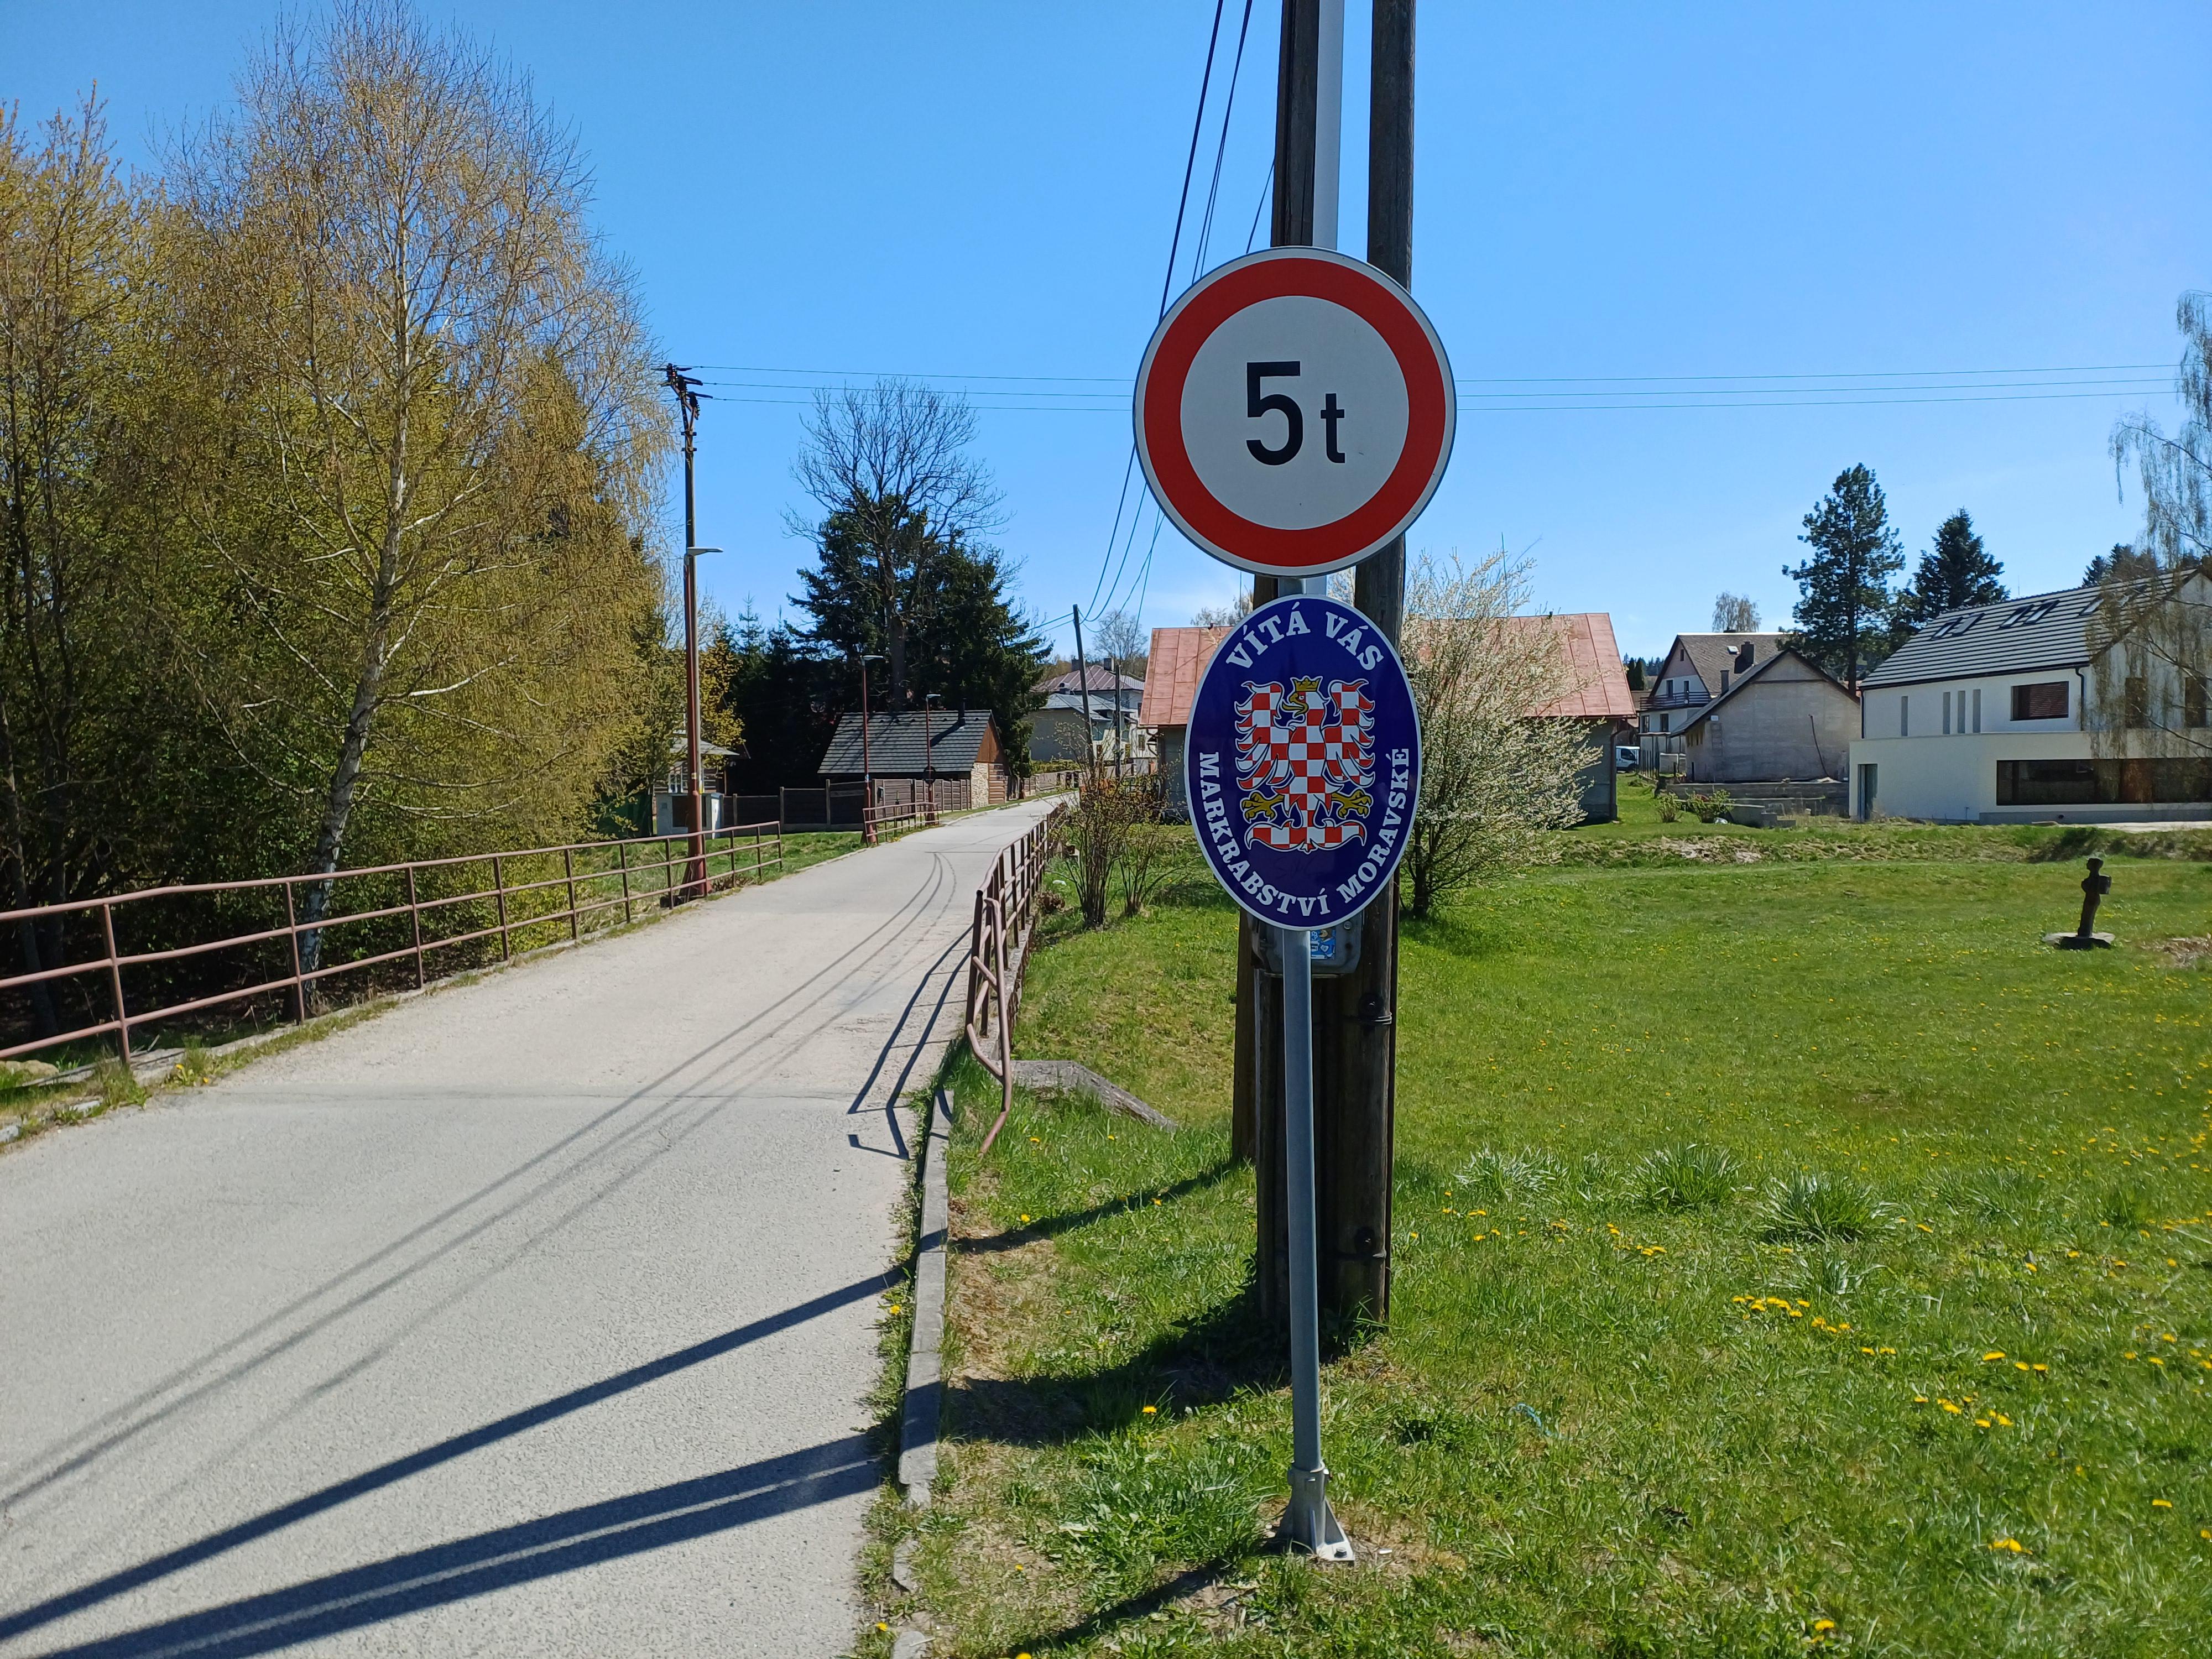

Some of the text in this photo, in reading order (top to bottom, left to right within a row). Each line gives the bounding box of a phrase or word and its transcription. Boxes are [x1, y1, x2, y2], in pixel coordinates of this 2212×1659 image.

[1225, 601, 1385, 671] VÍTÁ VÁS
[1199, 748, 1409, 917] MARKRABSTVÍ MORAVSKÉ
